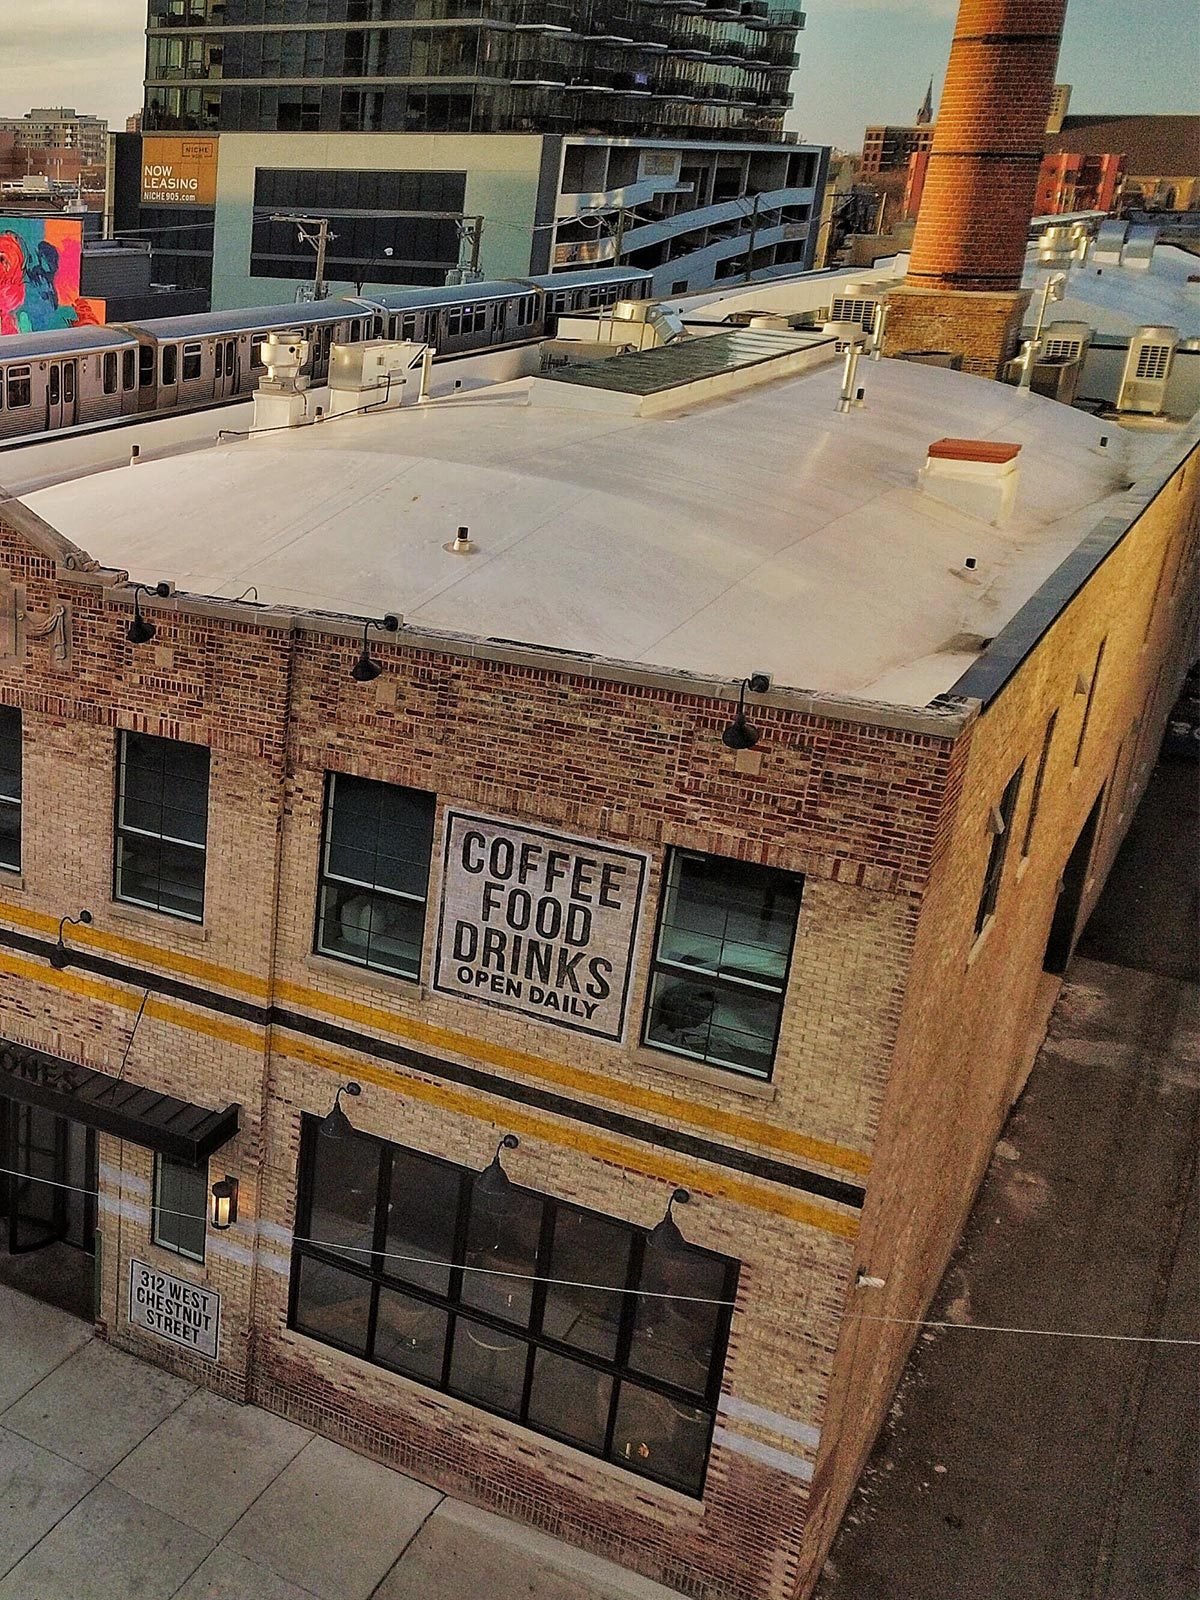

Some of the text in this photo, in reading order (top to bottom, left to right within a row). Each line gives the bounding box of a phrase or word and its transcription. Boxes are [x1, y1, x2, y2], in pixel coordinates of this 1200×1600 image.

[144, 165, 173, 177] NOW
[144, 178, 198, 190] LEASING
[143, 191, 196, 201] NICHE905.com
[461, 831, 627, 910] COFFEE
[481, 881, 592, 947] FOOD
[453, 920, 613, 1000] DRINKS
[457, 966, 600, 1020] OPEN DAILY
[136, 1286, 212, 1331] CHESTNUT
[140, 1270, 209, 1313] 312 WEST
[146, 1309, 200, 1344] STREET
